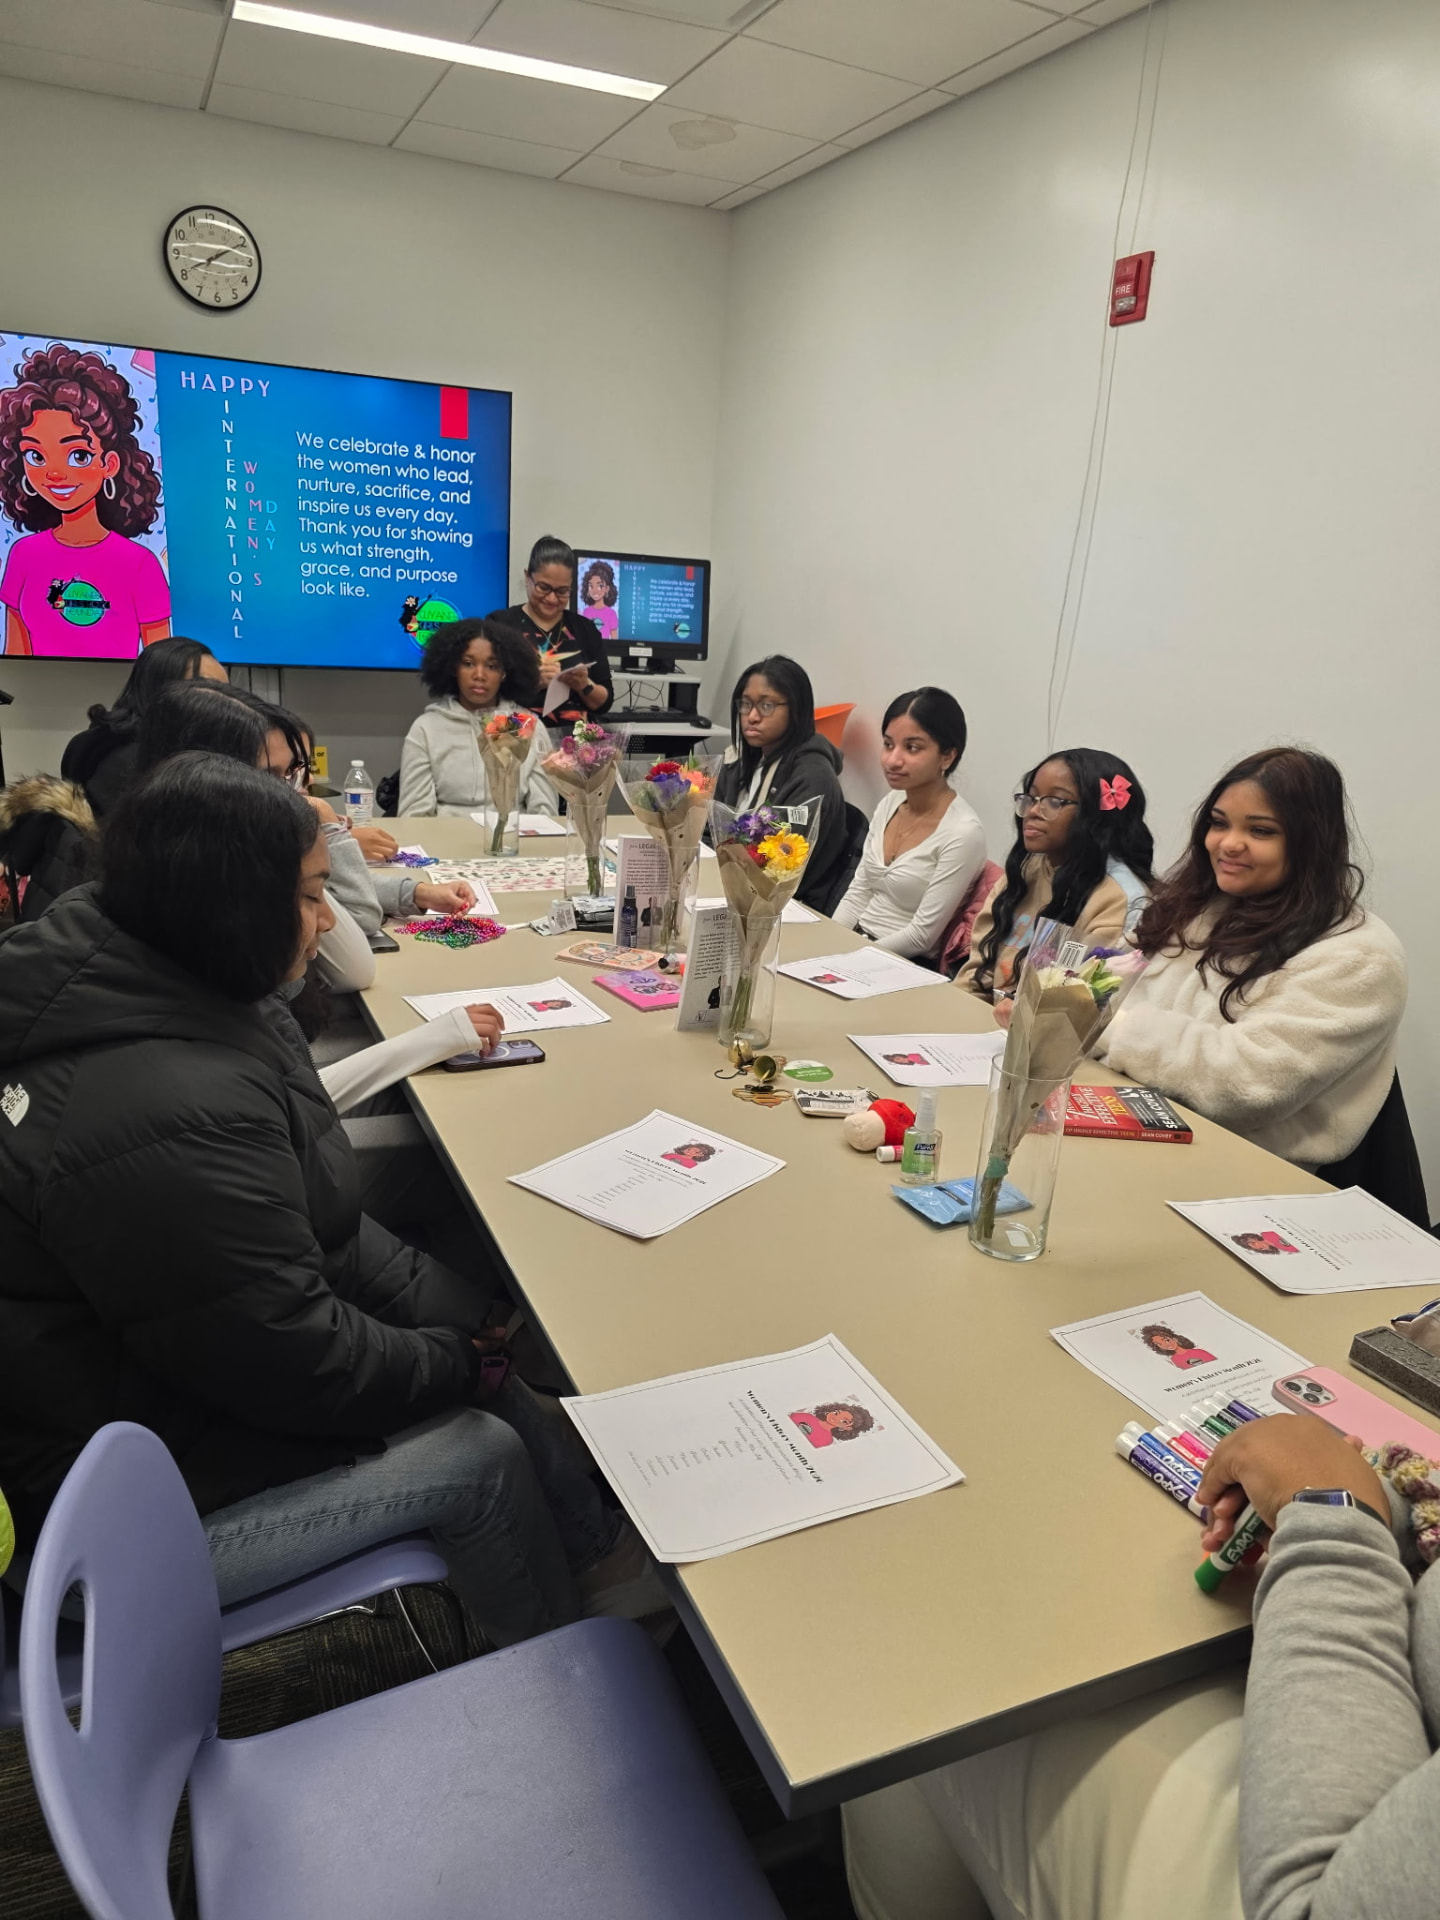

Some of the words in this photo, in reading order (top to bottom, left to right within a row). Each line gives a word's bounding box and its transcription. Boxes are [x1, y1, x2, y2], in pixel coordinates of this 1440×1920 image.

[188, 216, 196, 228] 11
[175, 229, 186, 241] 10
[172, 248, 181, 260] 9
[247, 257, 253, 268] 3
[180, 269, 188, 281] 8
[241, 275, 249, 287] 4
[196, 285, 203, 297] 7
[214, 292, 221, 303] 6
[231, 288, 239, 300] 5
[1115, 284, 1132, 296] FIRE
[180, 371, 270, 397] HAPPY
[296, 431, 324, 449] We
[328, 437, 409, 457] celebrate
[414, 444, 426, 459] &
[430, 445, 476, 464] honor
[297, 453, 324, 470] the
[329, 459, 391, 476] women
[395, 464, 430, 480] who
[433, 467, 473, 486] lead,
[298, 477, 360, 496] nurture,
[365, 483, 435, 502] sacrifice,
[439, 490, 471, 504] and
[298, 496, 350, 516] inspire
[354, 504, 371, 517] us
[375, 506, 420, 523] every
[423, 508, 458, 526] day.
[299, 517, 348, 535] Thank
[351, 525, 381, 539] you
[386, 524, 407, 539] for
[410, 526, 473, 548] showing
[300, 541, 317, 554] us
[320, 541, 363, 557] what
[367, 543, 434, 563] strength,
[300, 562, 354, 578] grace,
[359, 564, 391, 579] and
[395, 568, 458, 583] purpose
[301, 580, 335, 596] look
[339, 581, 370, 598] like.
[1138, 1088, 1163, 1111] COVEY
[1155, 1111, 1178, 1129] SEAN
[1162, 1455, 1200, 1482] EXPO
[1153, 1473, 1189, 1502] EXPO
